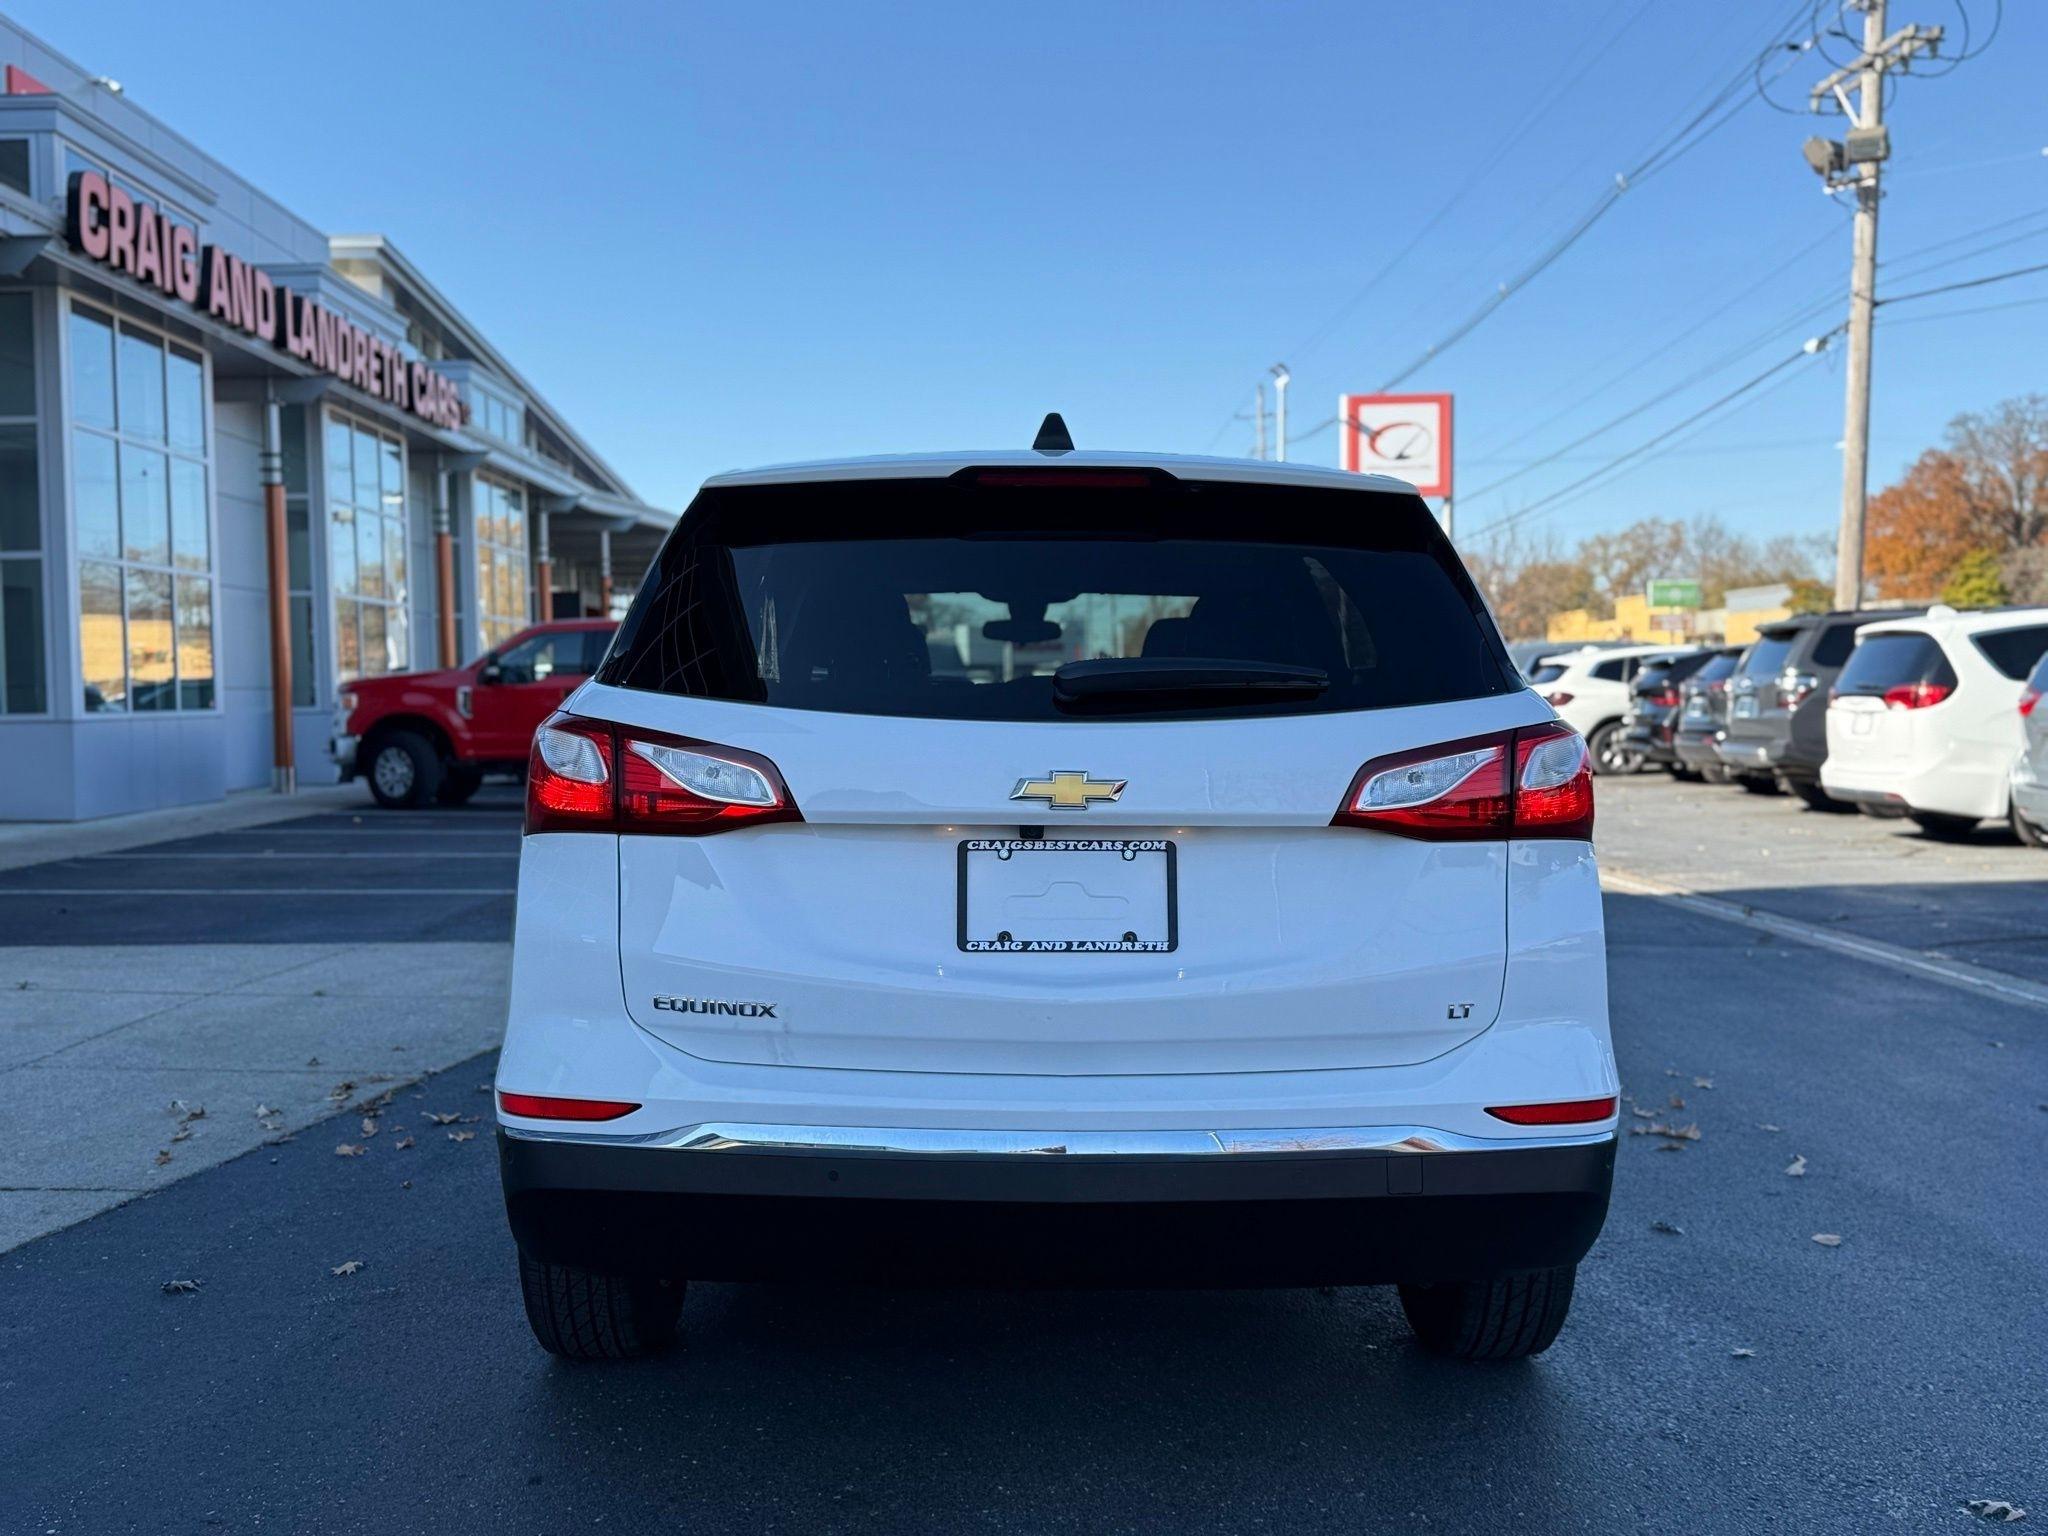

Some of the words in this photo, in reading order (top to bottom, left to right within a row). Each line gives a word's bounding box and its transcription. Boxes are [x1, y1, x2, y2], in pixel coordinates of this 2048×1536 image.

[76, 170, 199, 304] CRAIG
[207, 244, 277, 342] AND
[285, 286, 408, 409] LANDRETH
[412, 362, 461, 432] CARS
[966, 840, 1168, 851] CRAIGSBESTCARS.COM
[966, 941, 1025, 951] CRAIG
[1028, 941, 1068, 951] AND
[1071, 941, 1170, 951] LANDRETH
[653, 995, 778, 1018] EQUINOX
[1447, 1003, 1475, 1019] LT
